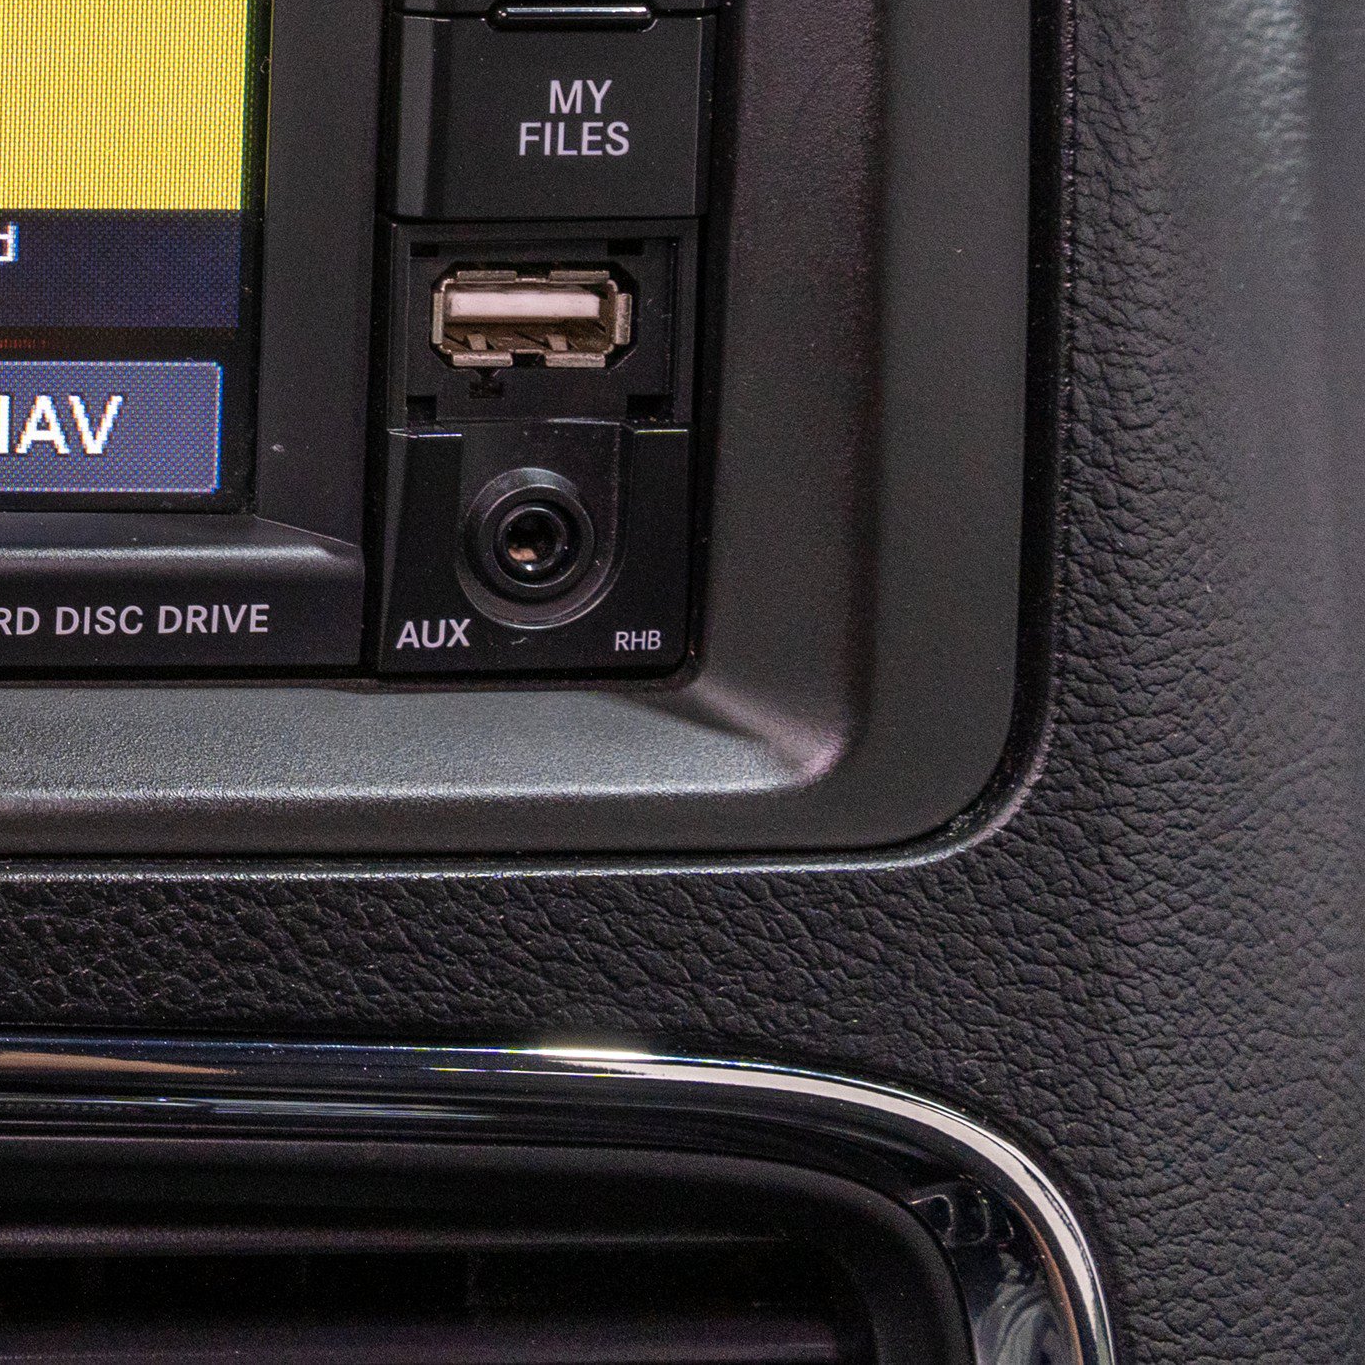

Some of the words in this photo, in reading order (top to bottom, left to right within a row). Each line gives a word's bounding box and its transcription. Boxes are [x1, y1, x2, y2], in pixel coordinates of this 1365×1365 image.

[548, 80, 612, 115] MY
[518, 121, 630, 156] FILES
[55, 605, 143, 635] DISC
[158, 604, 269, 634] DRIVE
[396, 619, 470, 649] AUX
[614, 631, 662, 652] RHB
